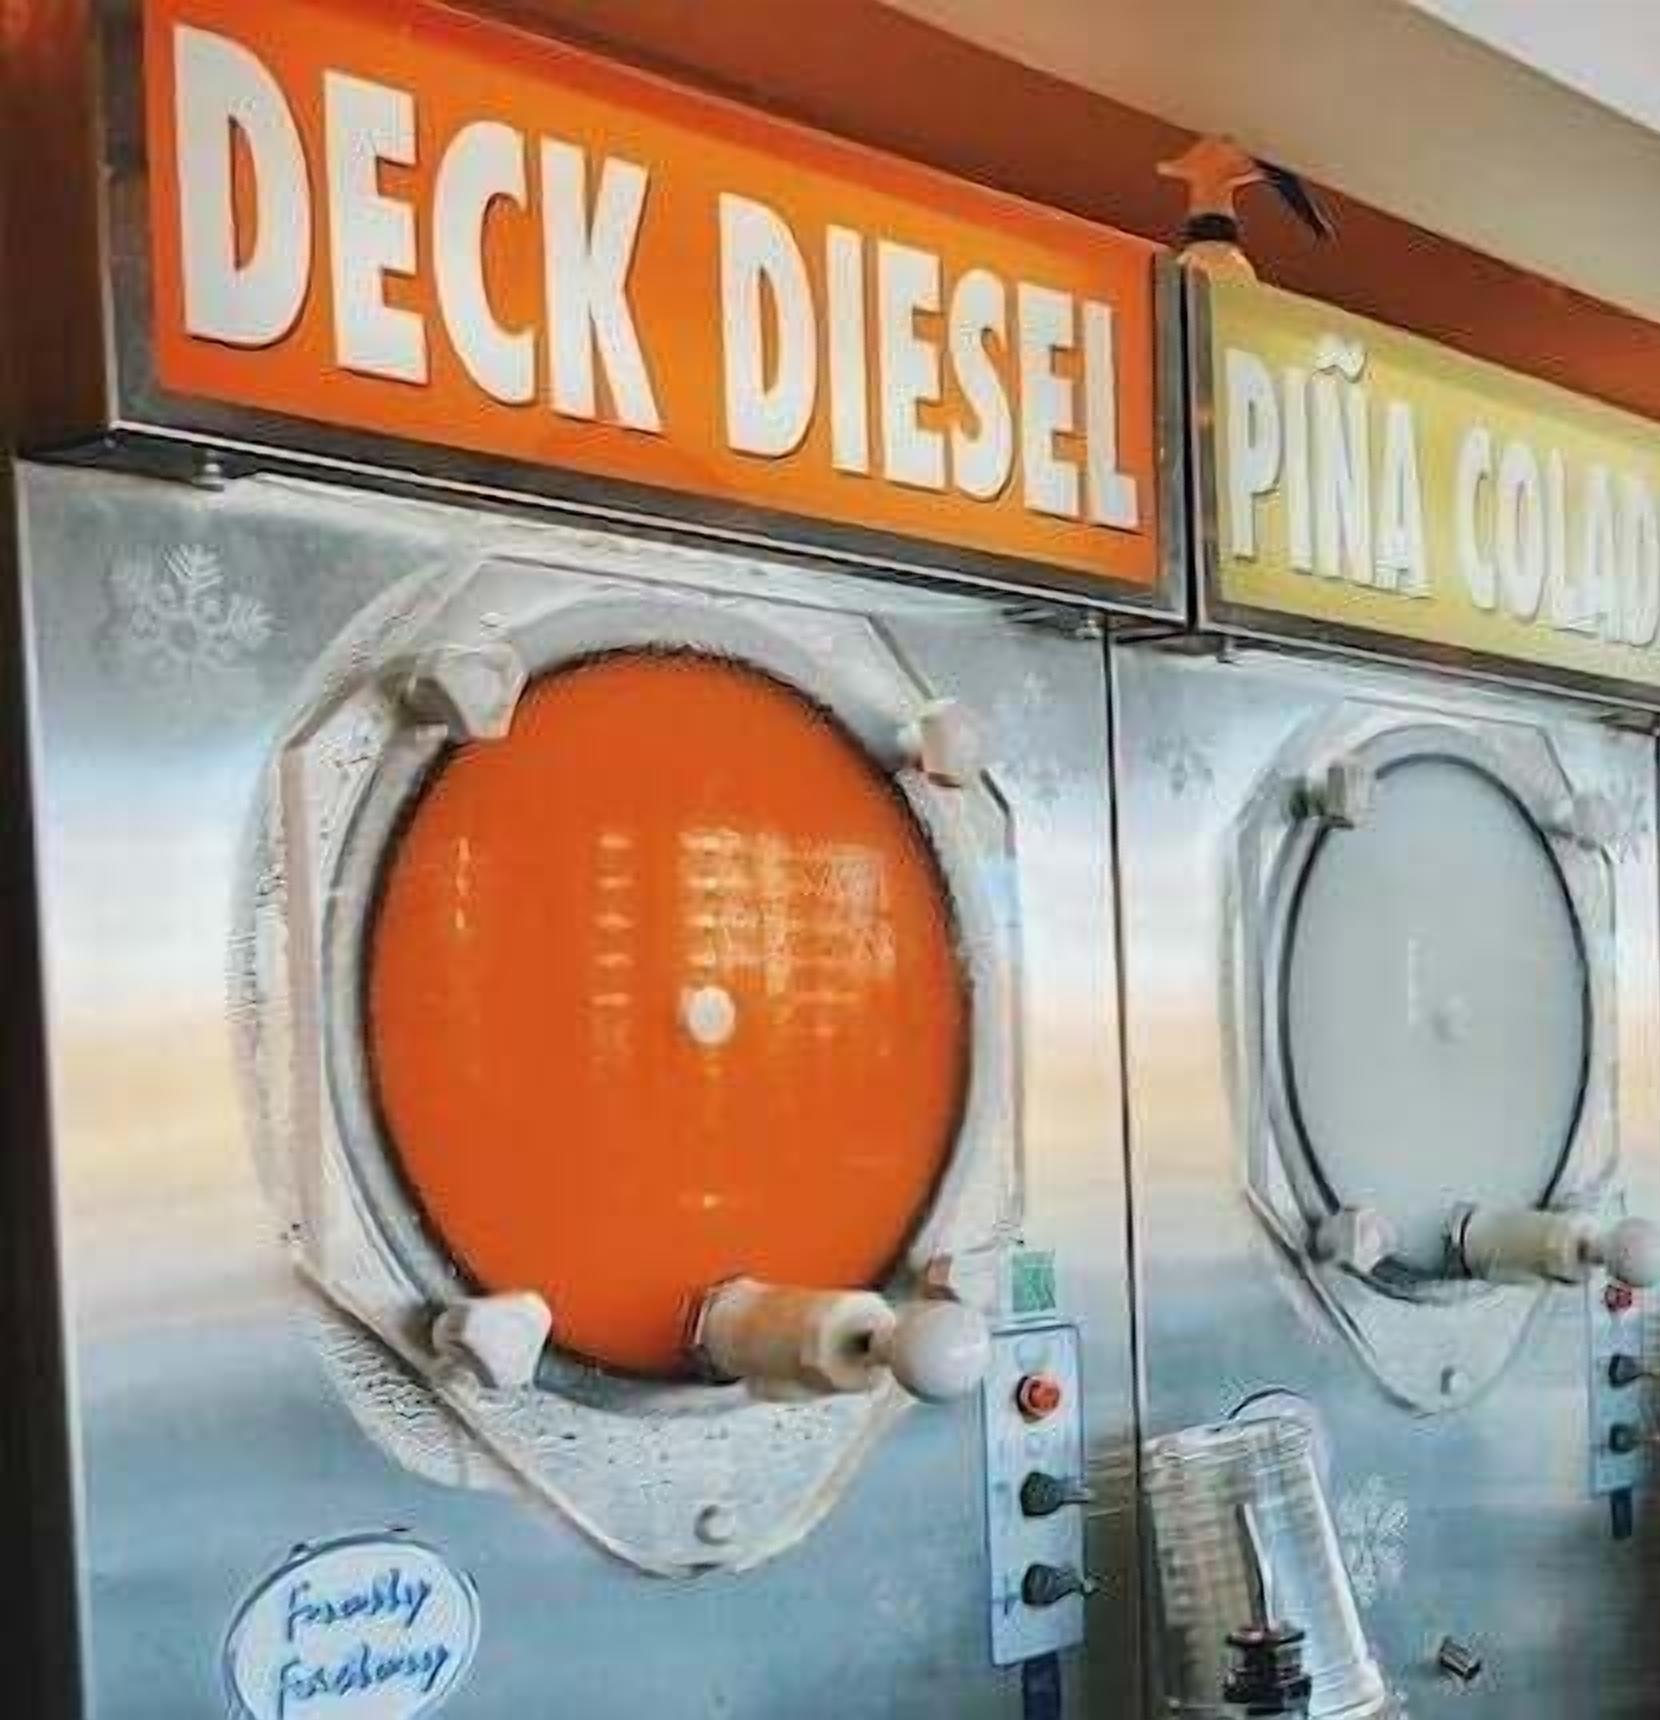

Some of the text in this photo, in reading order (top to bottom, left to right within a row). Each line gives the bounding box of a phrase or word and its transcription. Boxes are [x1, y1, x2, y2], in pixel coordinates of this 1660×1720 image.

[172, 22, 1140, 532] DECK DIESEL
[1225, 335, 1434, 600] PIÑA
